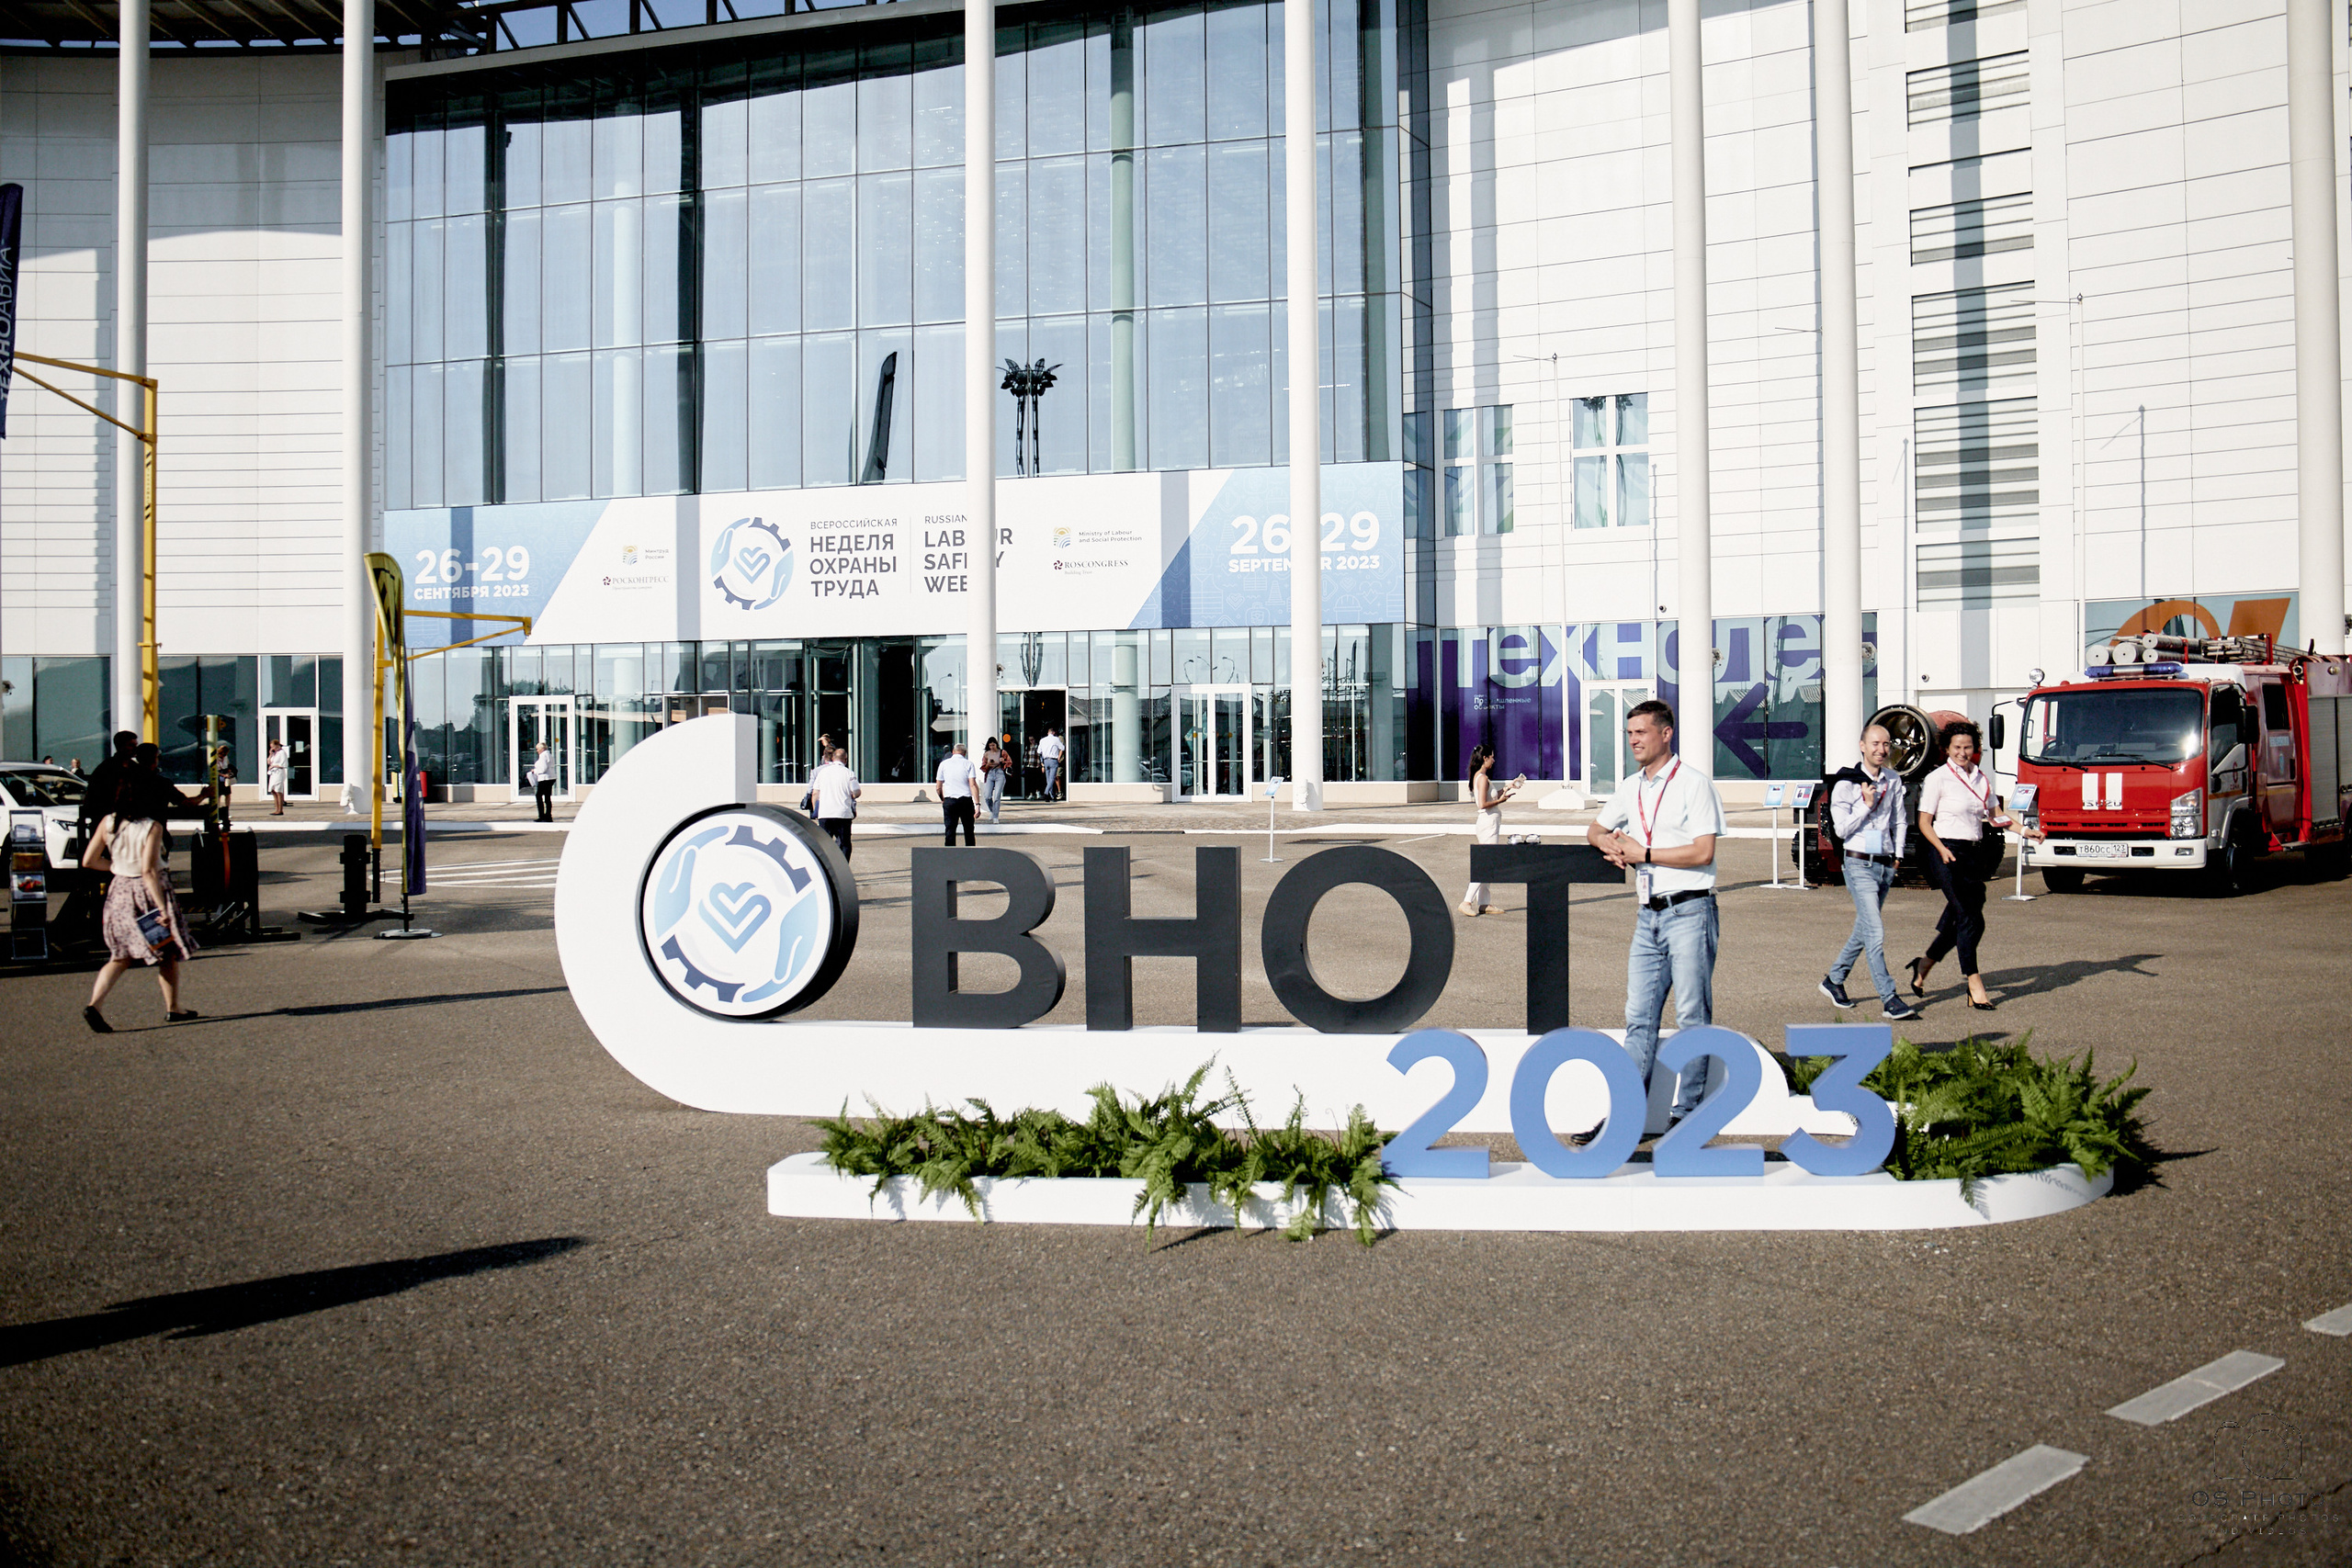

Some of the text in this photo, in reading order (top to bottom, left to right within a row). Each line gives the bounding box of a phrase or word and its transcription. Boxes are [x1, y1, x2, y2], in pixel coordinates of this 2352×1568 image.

[810, 517, 898, 530] ВСЕРОССИЙСКАЯ
[924, 514, 967, 524] RUSSIAN
[924, 528, 1013, 547] LABR
[1230, 511, 1380, 555] 2629
[810, 533, 895, 555] НЕДЕЛЯ
[414, 545, 531, 584] 26-29
[809, 556, 898, 575] ОХРАНЫ
[923, 551, 1005, 570] SAFY
[1064, 559, 1129, 569] ROSCONGRESS
[1336, 555, 1380, 570] 2023
[612, 575, 670, 584] РОСКОНГРЕСС
[810, 579, 880, 599] ТРУДА
[923, 575, 967, 592] WEE
[413, 583, 530, 600] СЕНТЯБРЯ 2023
[911, 842, 1626, 1035] ВНОТ
[1381, 1021, 1898, 1179] 2023
